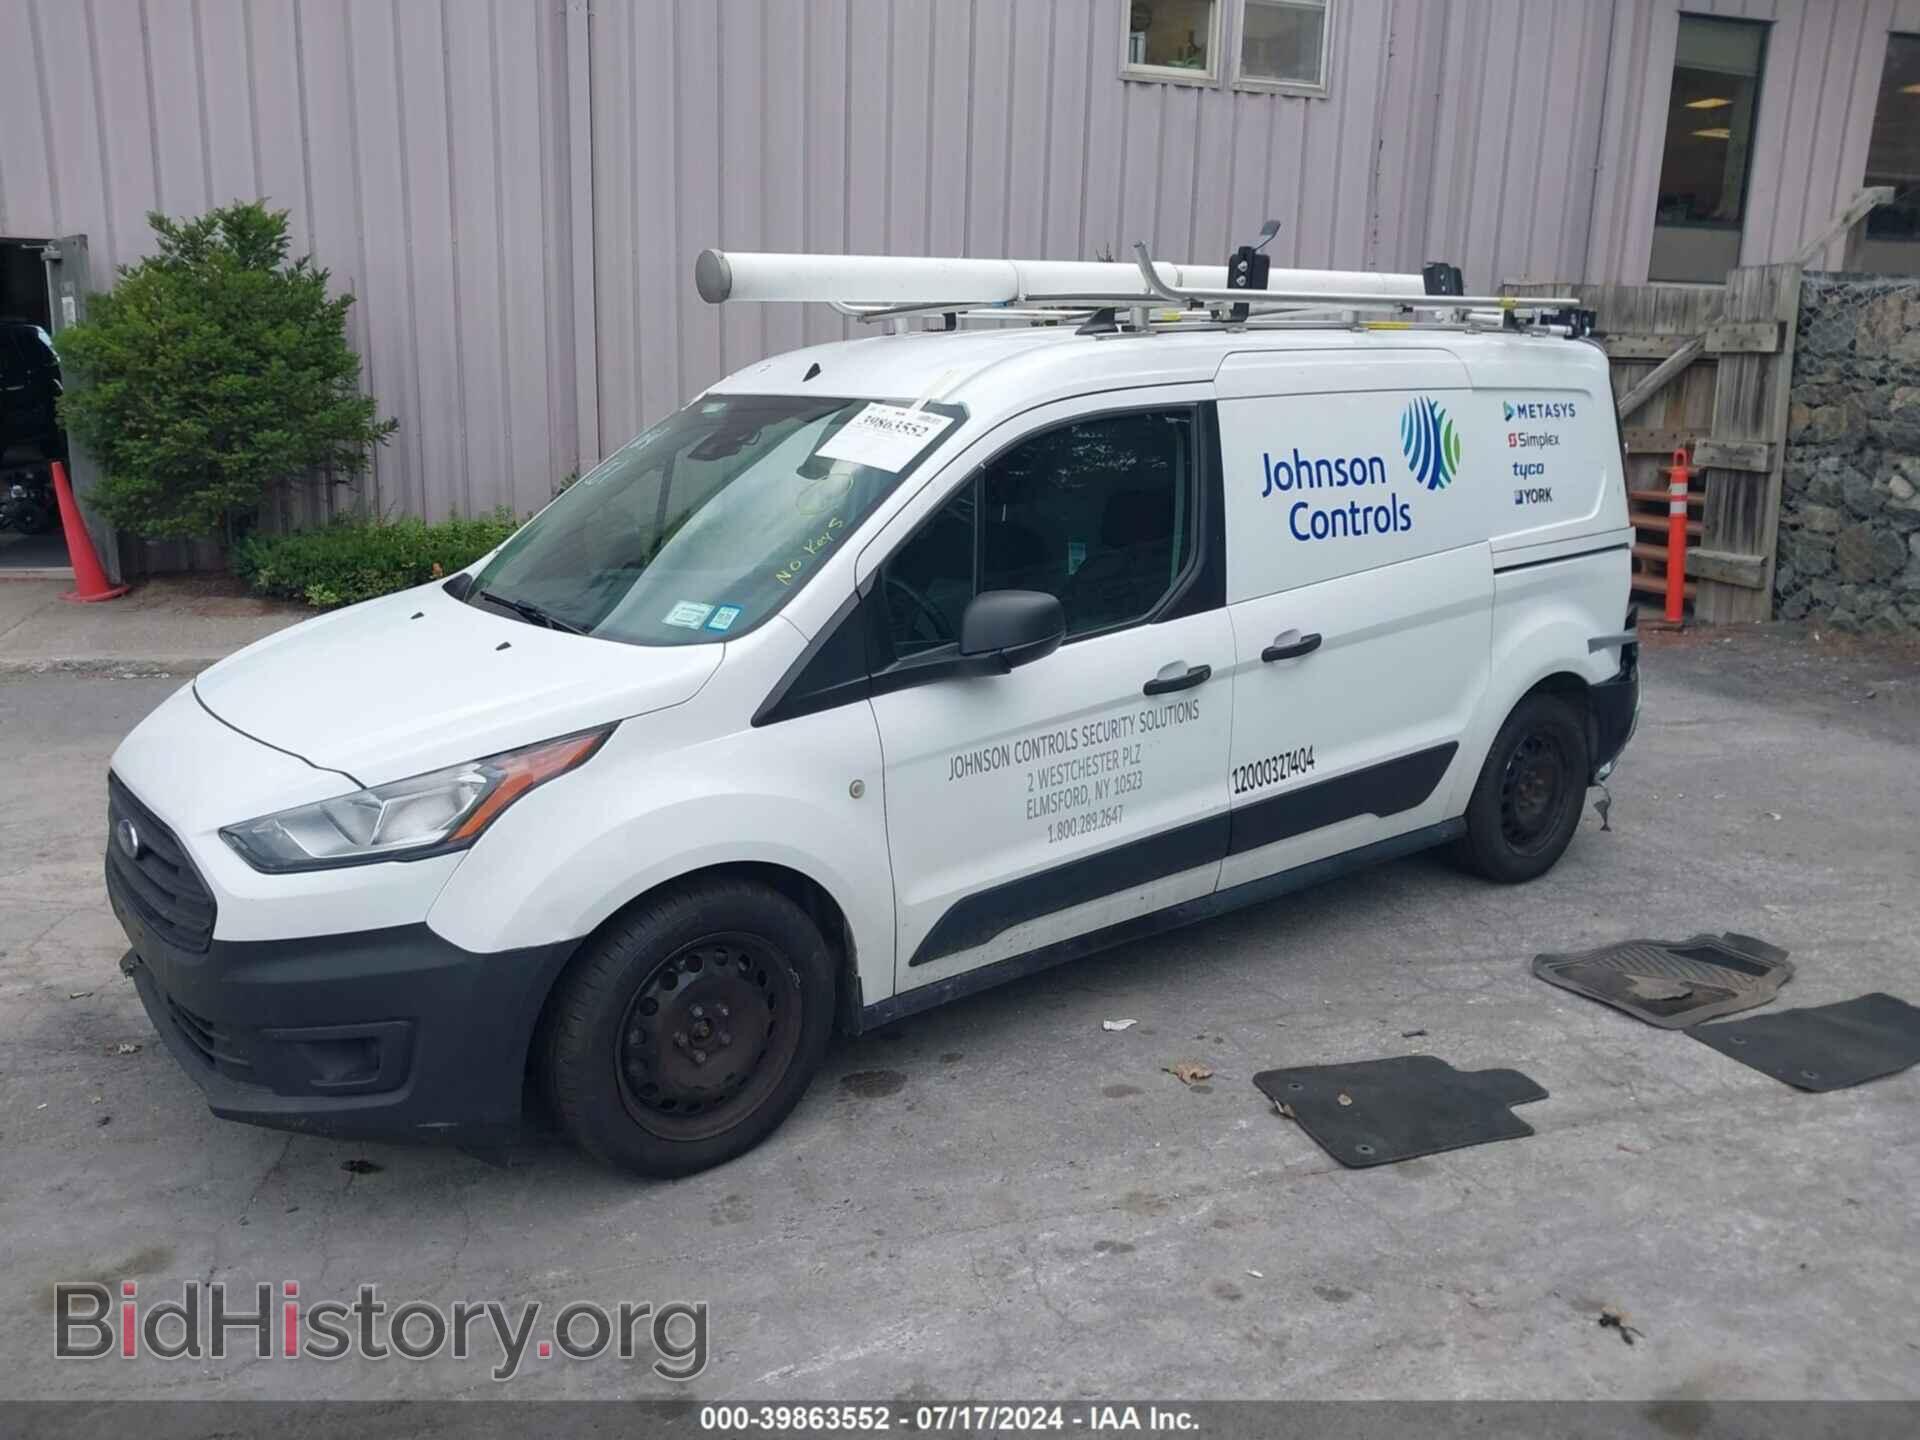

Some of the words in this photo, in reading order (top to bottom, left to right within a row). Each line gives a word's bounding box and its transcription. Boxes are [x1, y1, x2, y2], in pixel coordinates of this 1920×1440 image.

[1517, 403, 1576, 419] METASYS
[1518, 432, 1560, 450] Simplex
[1261, 448, 1387, 498] Johnson
[1512, 461, 1545, 480] tyco
[1289, 492, 1412, 541] Controls
[1523, 487, 1553, 504] YORK
[948, 744, 1010, 782] JOHNSON
[1014, 728, 1079, 764] CONTROLS
[1081, 714, 1136, 748] SECURITY
[1139, 698, 1200, 734] SOLUTIONS
[1027, 772, 1035, 793] 2
[1037, 749, 1120, 790] WESTCHESTER
[1122, 743, 1142, 768] PLZ
[1232, 744, 1315, 795] 12000327404
[1026, 784, 1091, 821] ELMSFORD,
[1094, 777, 1111, 801] NY
[1114, 770, 1144, 796] 10523
[1046, 803, 1124, 844] 1.800.289.2647
